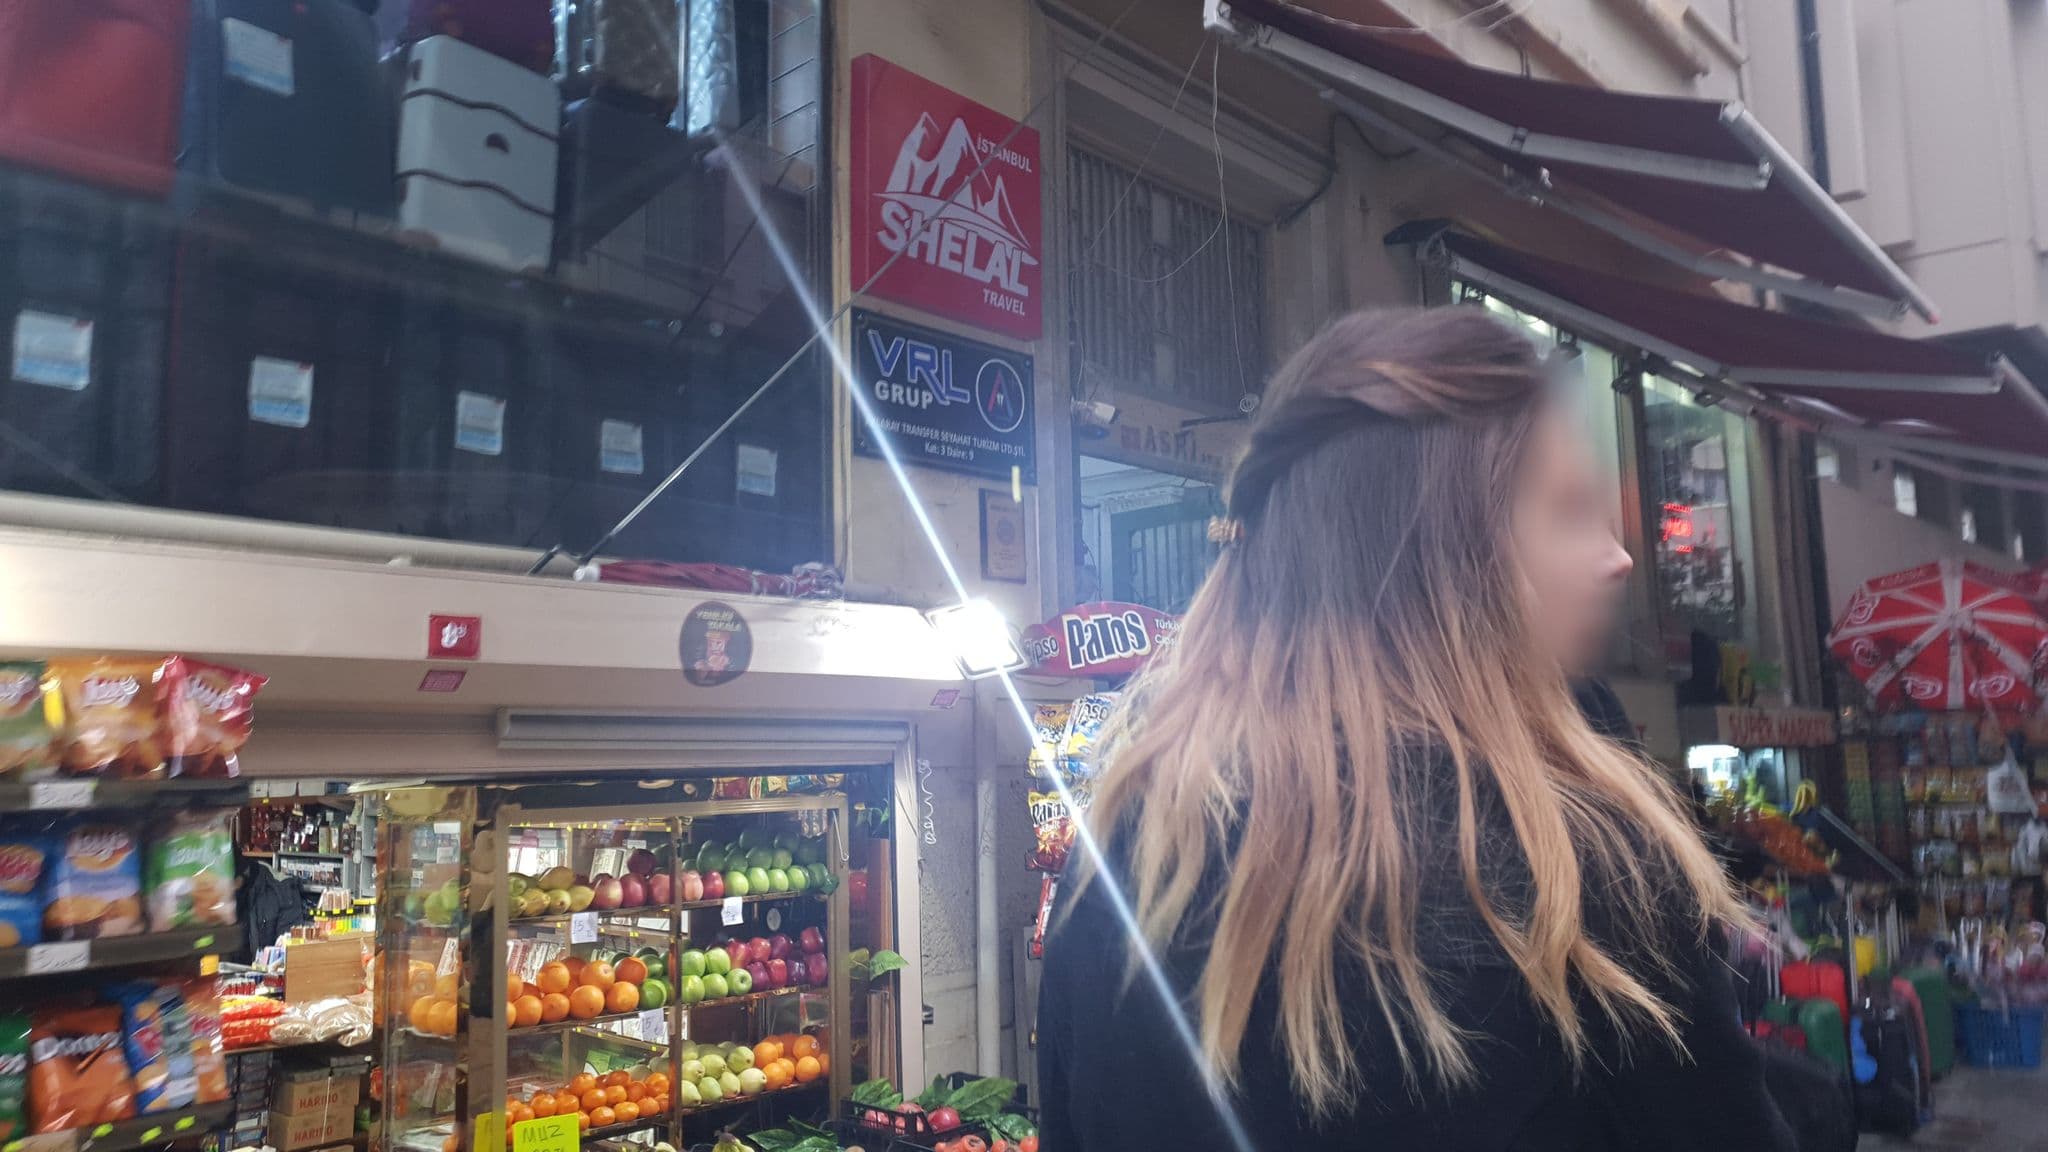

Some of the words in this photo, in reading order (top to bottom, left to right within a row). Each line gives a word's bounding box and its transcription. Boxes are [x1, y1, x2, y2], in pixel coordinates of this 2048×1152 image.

[877, 200, 1029, 298] SHELAL
[982, 288, 1026, 316] TRAVEL
[868, 329, 970, 406] VRL
[874, 379, 934, 410] GRUP
[522, 1124, 565, 1144] MUZ
